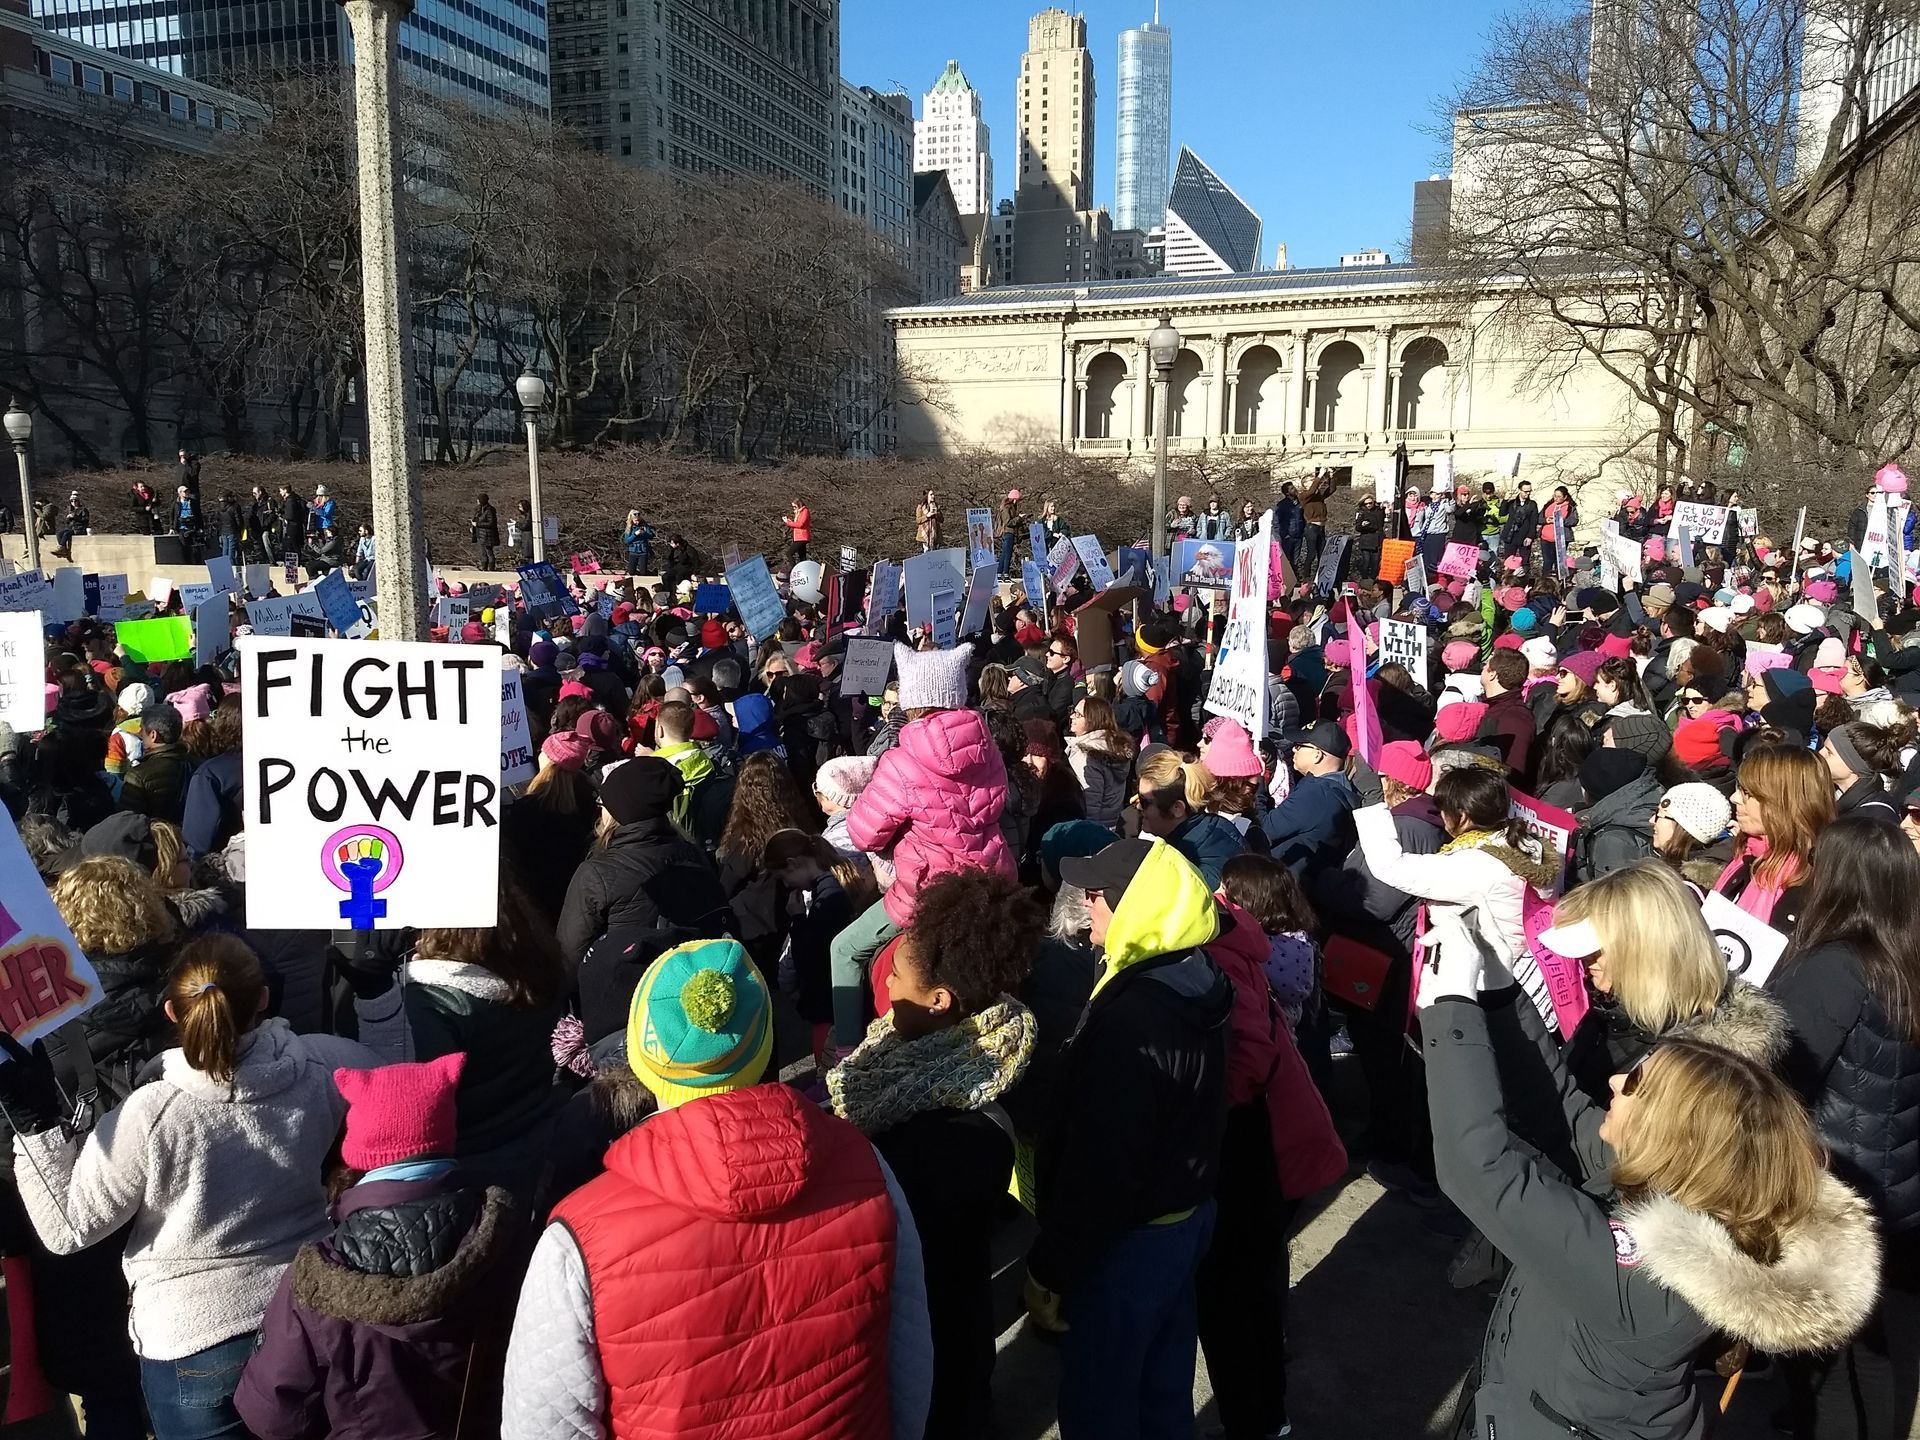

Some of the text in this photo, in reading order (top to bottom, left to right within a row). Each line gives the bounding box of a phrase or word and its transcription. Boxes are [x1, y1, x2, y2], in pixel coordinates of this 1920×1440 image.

[1677, 503, 1696, 514] Let
[1681, 514, 1725, 527] not grow
[841, 548, 856, 560] NO!
[84, 581, 98, 589] the
[1200, 575, 1216, 585] Change
[1387, 621, 1416, 641] I'M
[1383, 636, 1422, 657] WITH
[257, 648, 485, 725] FIGHT
[501, 707, 521, 732] asty
[341, 726, 393, 754] the
[501, 745, 530, 772] OTE
[258, 757, 498, 828] POWER
[0, 943, 87, 1034] HER
